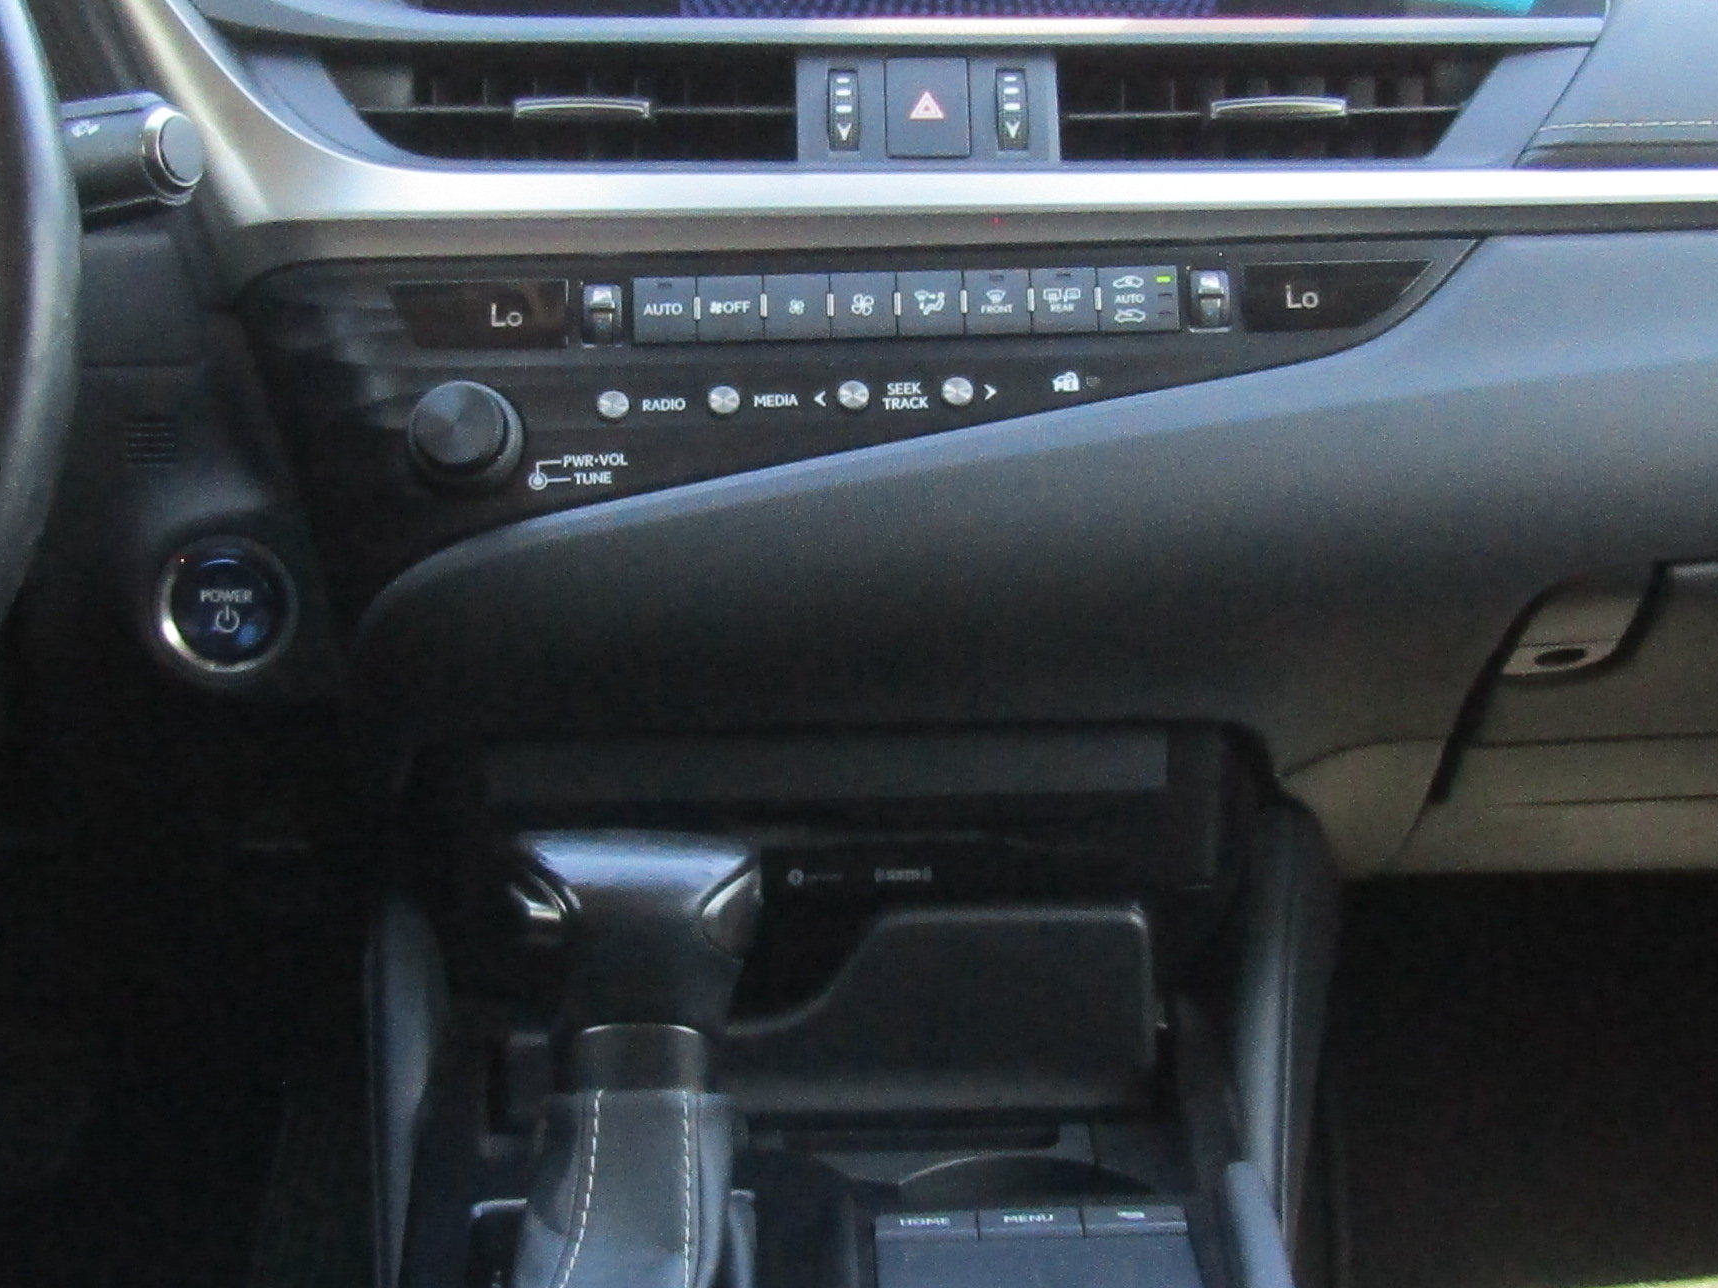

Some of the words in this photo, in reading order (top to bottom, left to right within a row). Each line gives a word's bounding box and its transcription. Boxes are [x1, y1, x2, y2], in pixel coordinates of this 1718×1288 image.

[1114, 293, 1145, 305] AUTO
[1285, 284, 1318, 309] Lo
[643, 303, 683, 316] AUTO
[722, 300, 751, 314] OFF
[981, 303, 1014, 314] FRONT
[1049, 303, 1075, 313] REAR
[490, 302, 523, 327] Lo
[886, 382, 922, 396] SEEK
[642, 398, 686, 412] RADIO
[754, 394, 799, 408] MEDIA
[883, 396, 929, 411] TRACK
[574, 472, 612, 486] TUNE
[200, 589, 253, 604] POWER
[899, 1217, 951, 1227] HOME
[1003, 1214, 1054, 1224] MENU
